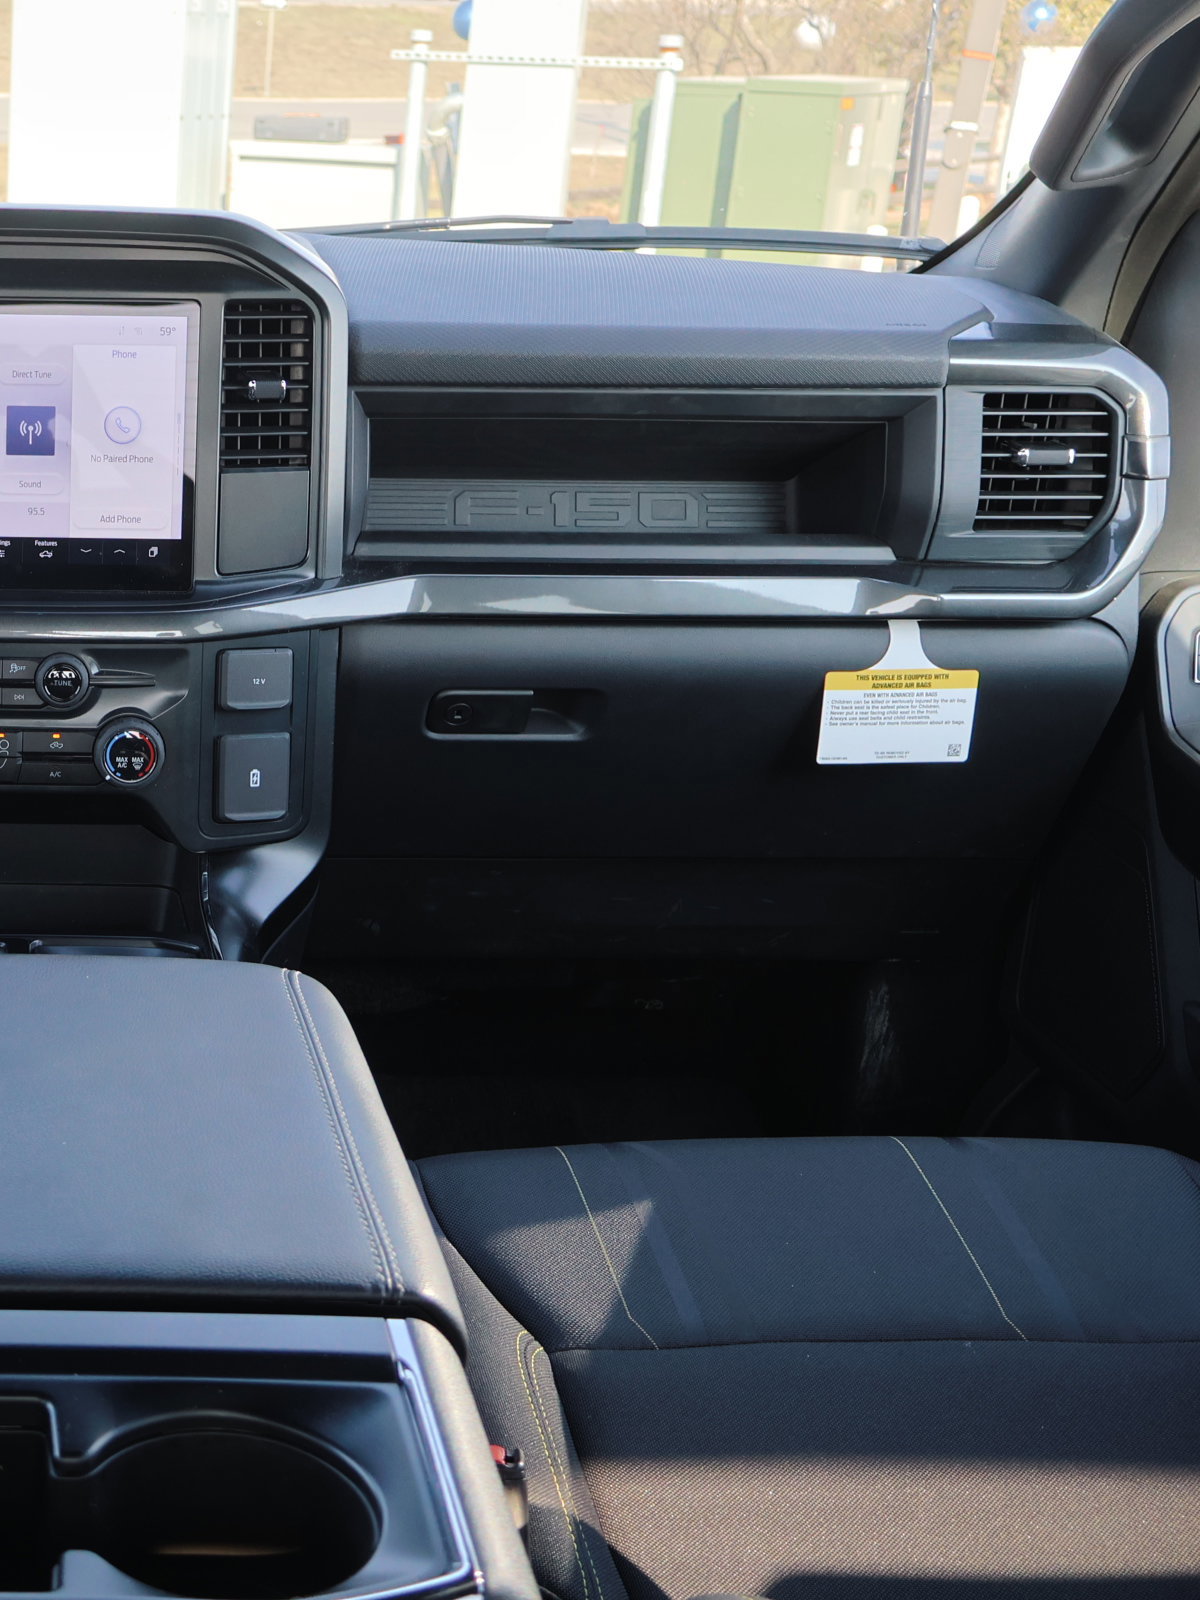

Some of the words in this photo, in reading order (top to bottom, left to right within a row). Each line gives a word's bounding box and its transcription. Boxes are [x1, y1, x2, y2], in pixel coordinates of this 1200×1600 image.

[111, 350, 138, 359] Phone
[12, 370, 33, 379] Direct
[34, 370, 52, 379] Tune
[90, 454, 102, 463] No
[103, 454, 128, 464] Paired
[129, 454, 154, 464] Phone
[19, 480, 42, 489] Sound
[27, 507, 45, 516] 95.5
[453, 489, 701, 528] F-150
[100, 515, 116, 524] Add
[117, 515, 142, 524] Phone
[34, 539, 58, 547] Features
[54, 679, 73, 687] TUNE
